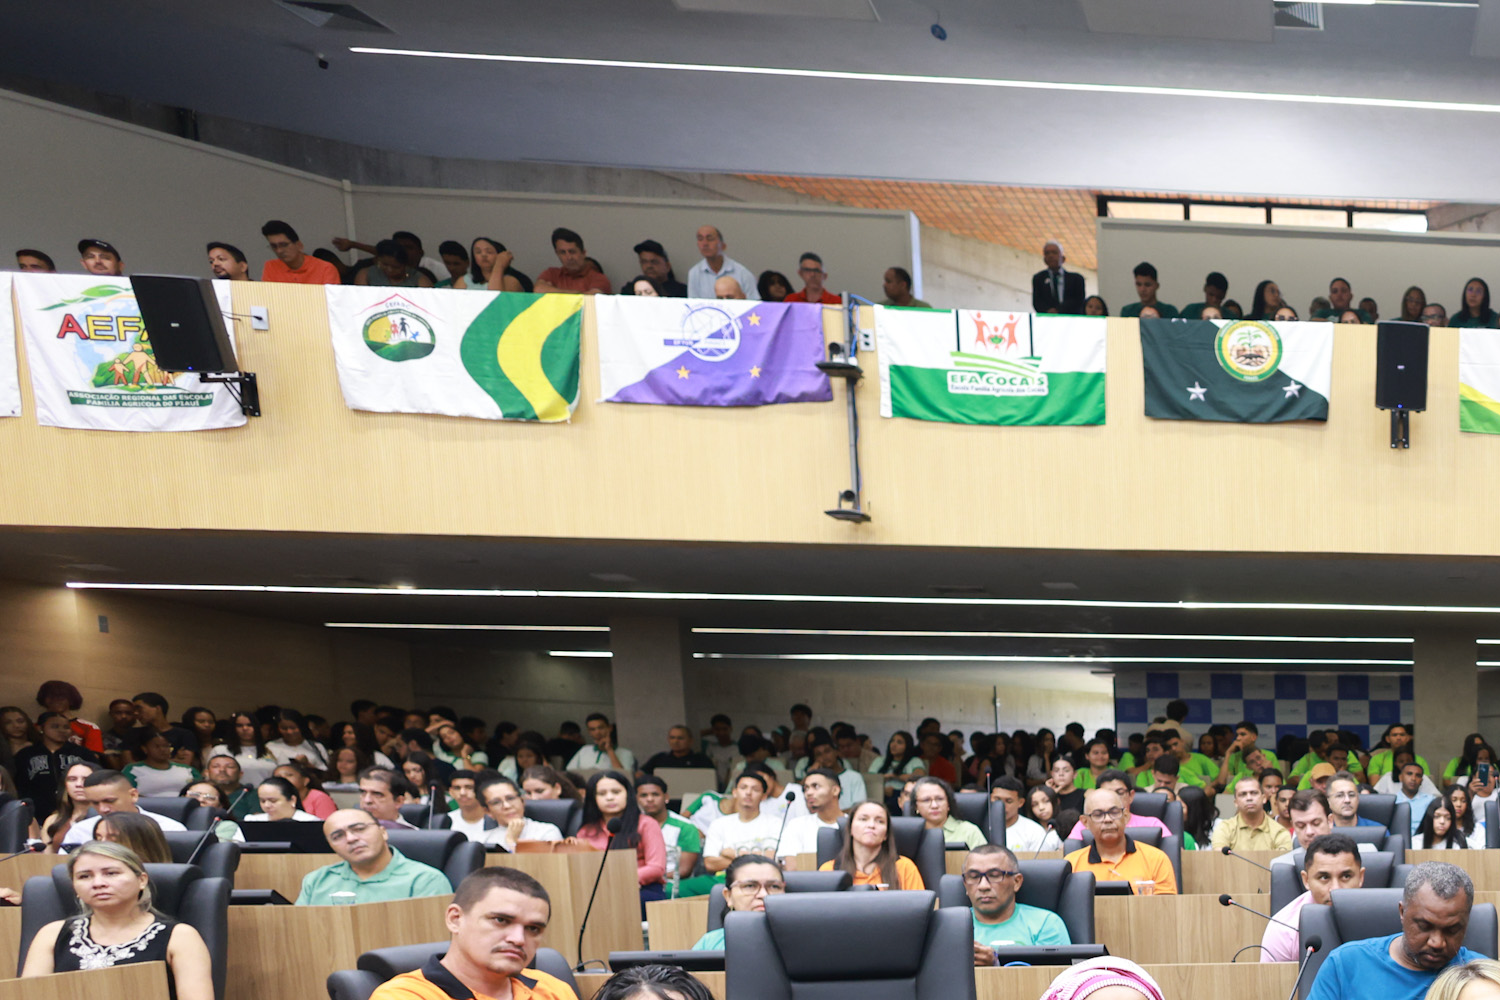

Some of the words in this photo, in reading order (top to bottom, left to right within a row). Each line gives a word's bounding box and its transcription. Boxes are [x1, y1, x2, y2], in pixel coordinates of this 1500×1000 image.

[57, 313, 150, 342] AEF
[950, 374, 980, 384] EFA
[68, 391, 120, 401] ASSOCIAÇÃO
[121, 392, 161, 402] REGIONAL
[162, 392, 177, 401] DAS
